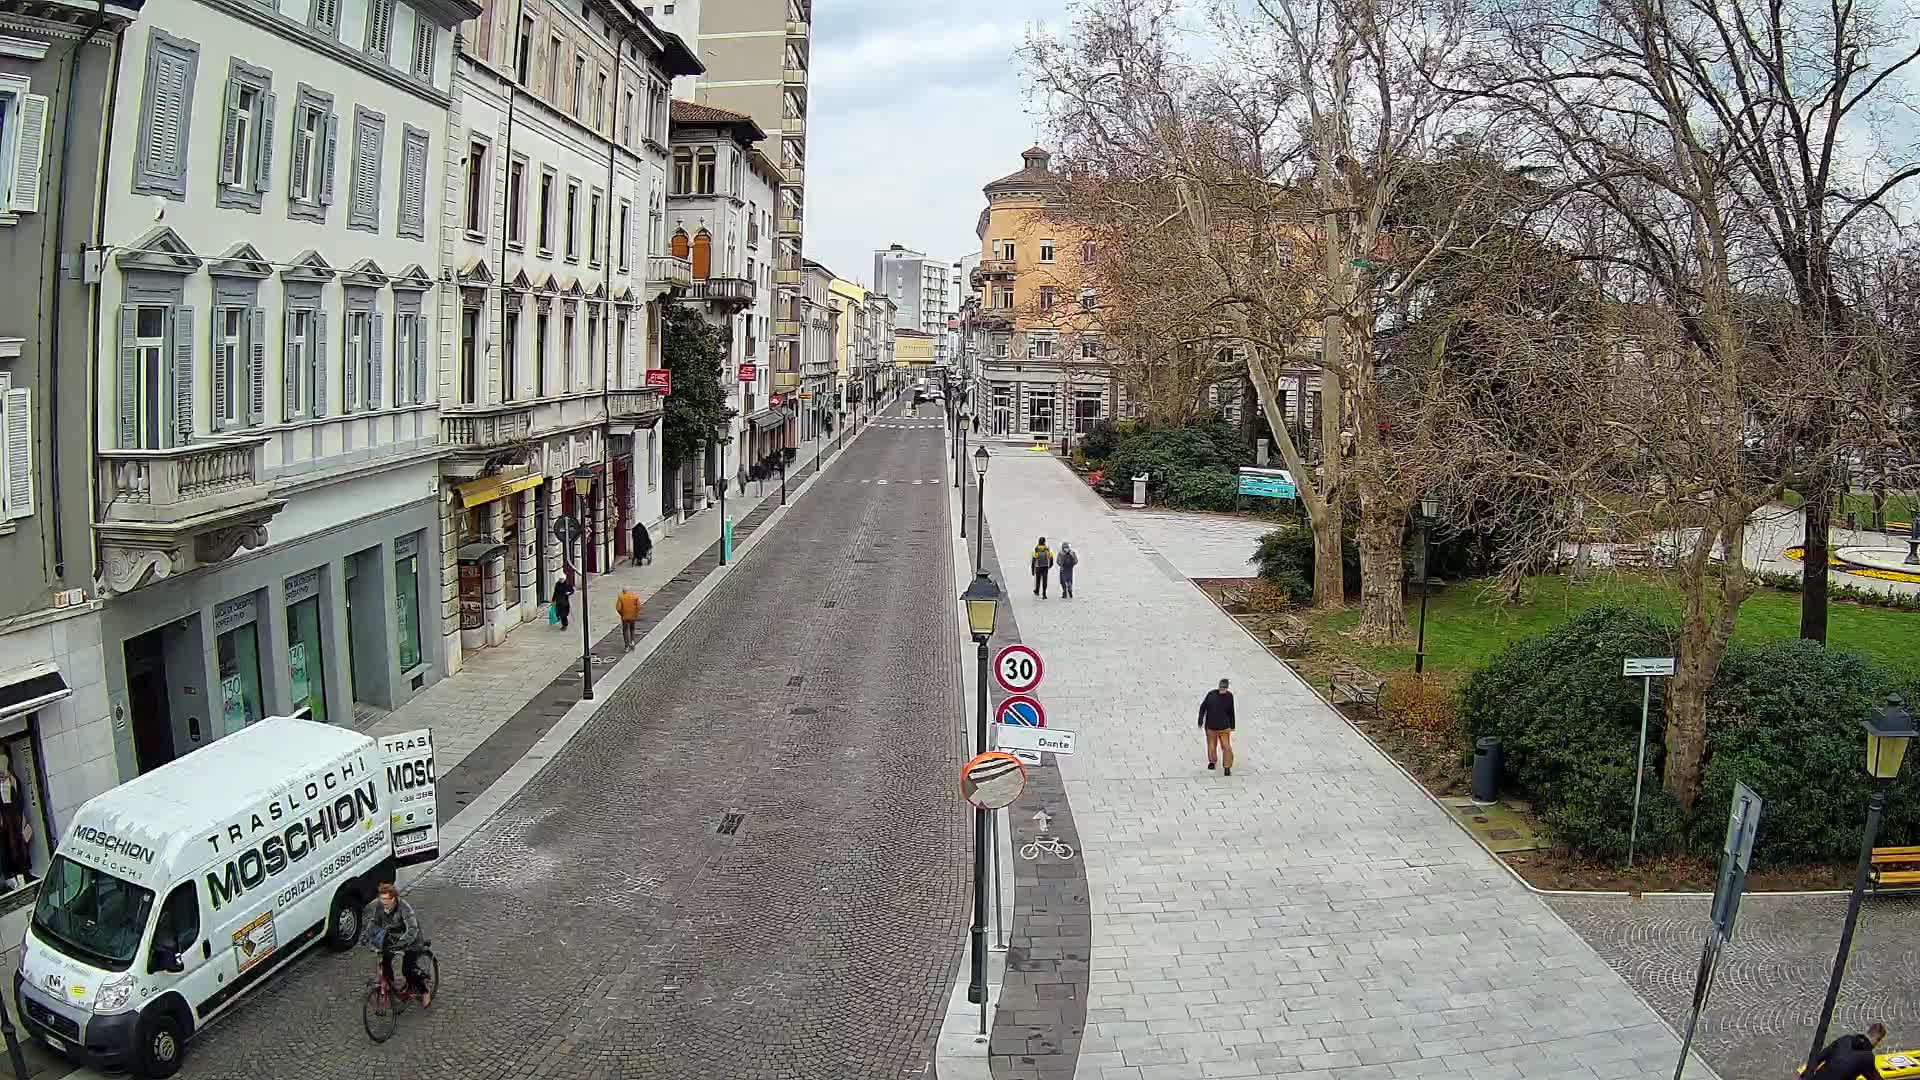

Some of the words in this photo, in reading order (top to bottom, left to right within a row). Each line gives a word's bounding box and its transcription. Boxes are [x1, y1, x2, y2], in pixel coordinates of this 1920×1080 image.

[1005, 658, 1034, 680] 30
[222, 677, 241, 700] 130
[1038, 737, 1070, 749] Dante
[208, 757, 366, 853] TRASLOCHI
[72, 824, 155, 865] MOSCHION
[206, 780, 380, 911] MOSCHION
[277, 875, 316, 907] GORIZIA
